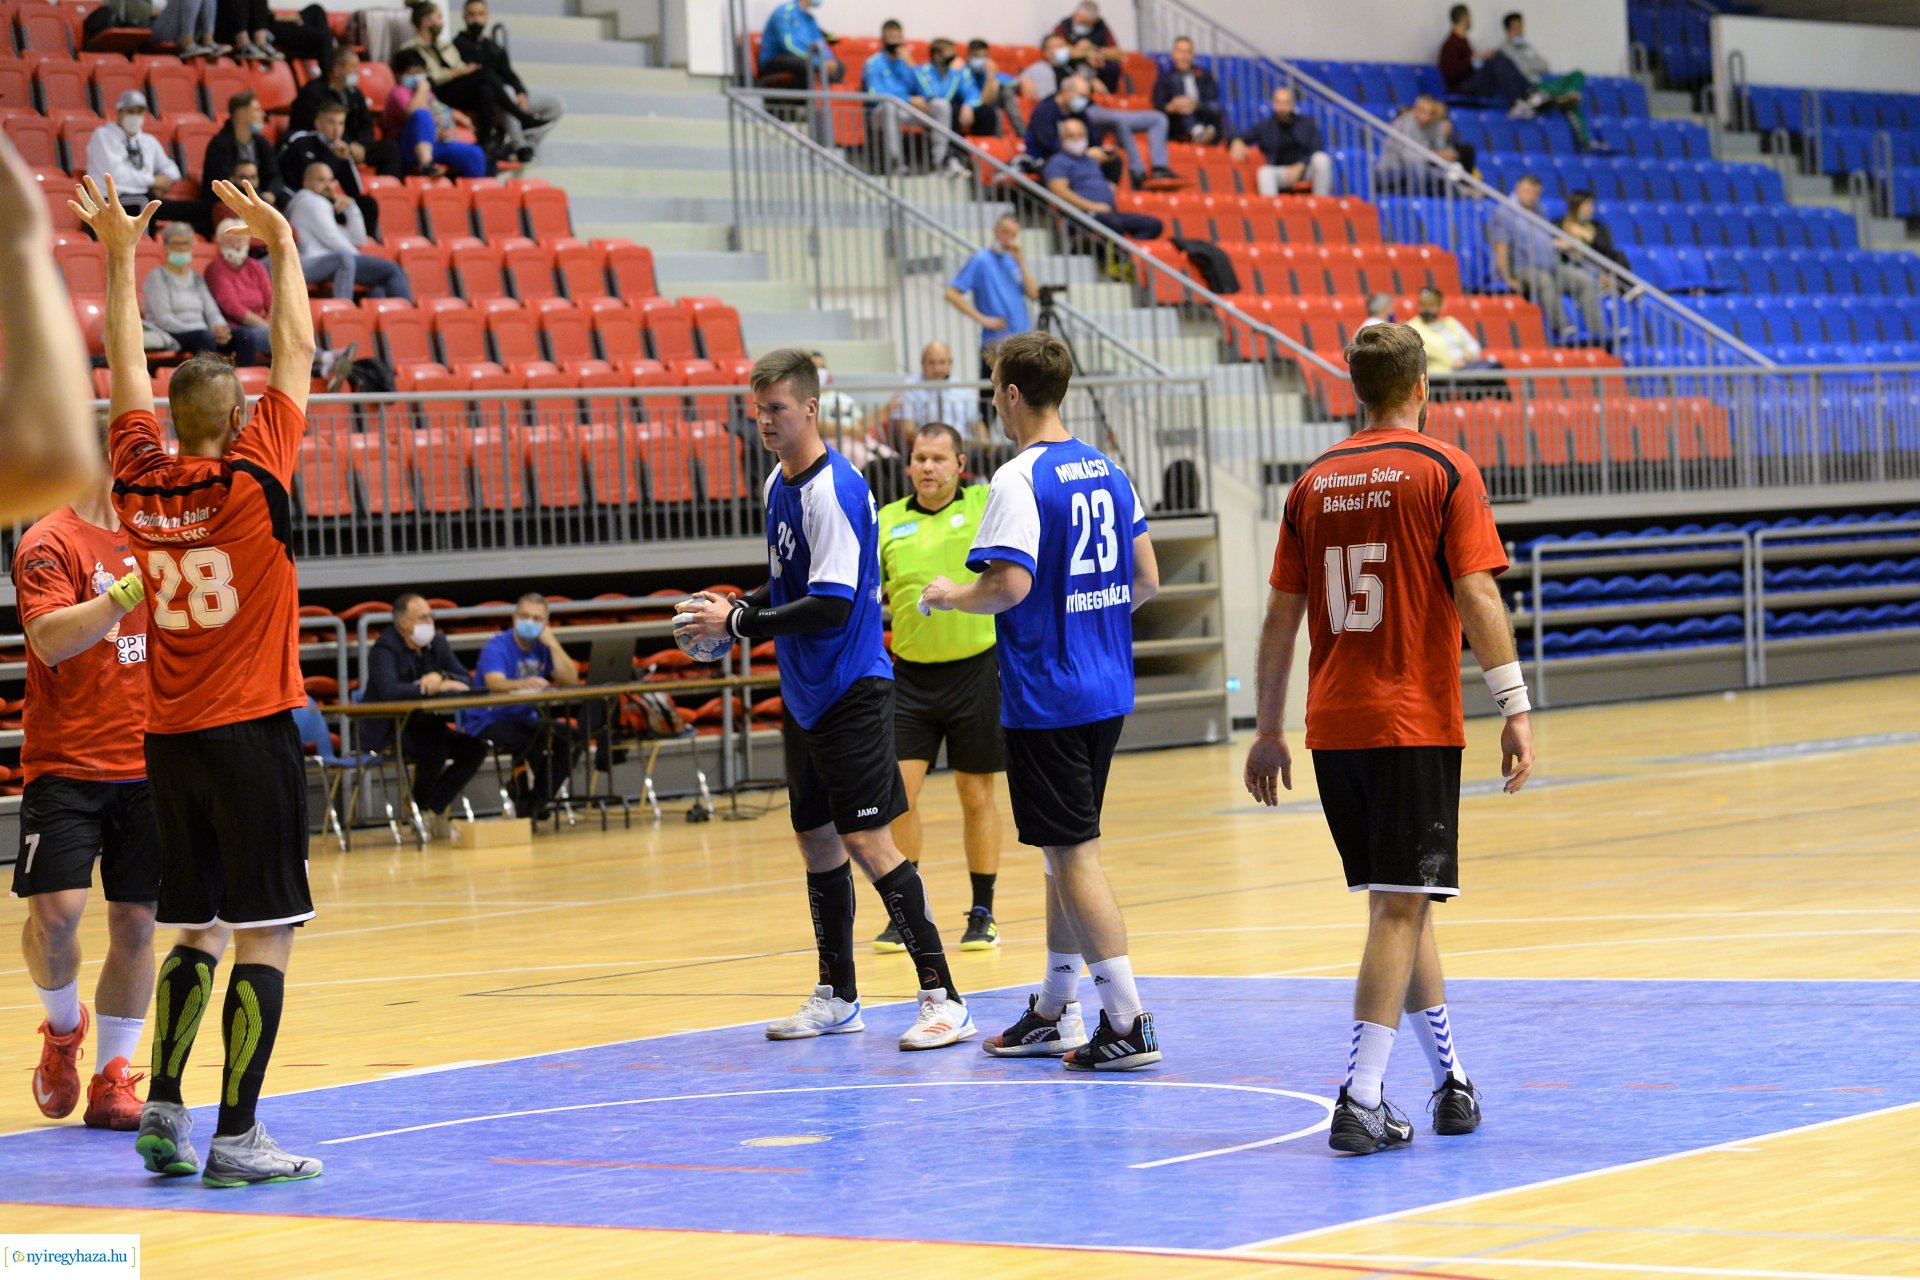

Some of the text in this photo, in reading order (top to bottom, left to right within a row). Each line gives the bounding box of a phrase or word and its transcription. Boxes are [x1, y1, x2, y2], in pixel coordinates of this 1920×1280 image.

[1313, 472, 1367, 493] Optimum
[1370, 466, 1404, 484] Solar
[1323, 490, 1392, 513] Békési FKC
[182, 506, 210, 526] Solar
[181, 527, 210, 542] FKC
[1070, 488, 1118, 576] 23
[148, 547, 240, 630] 28
[1324, 543, 1388, 634] 15
[116, 635, 146, 650] OPT
[118, 649, 146, 664] SOL
[857, 806, 879, 818] JAKO
[25, 833, 41, 874] 7
